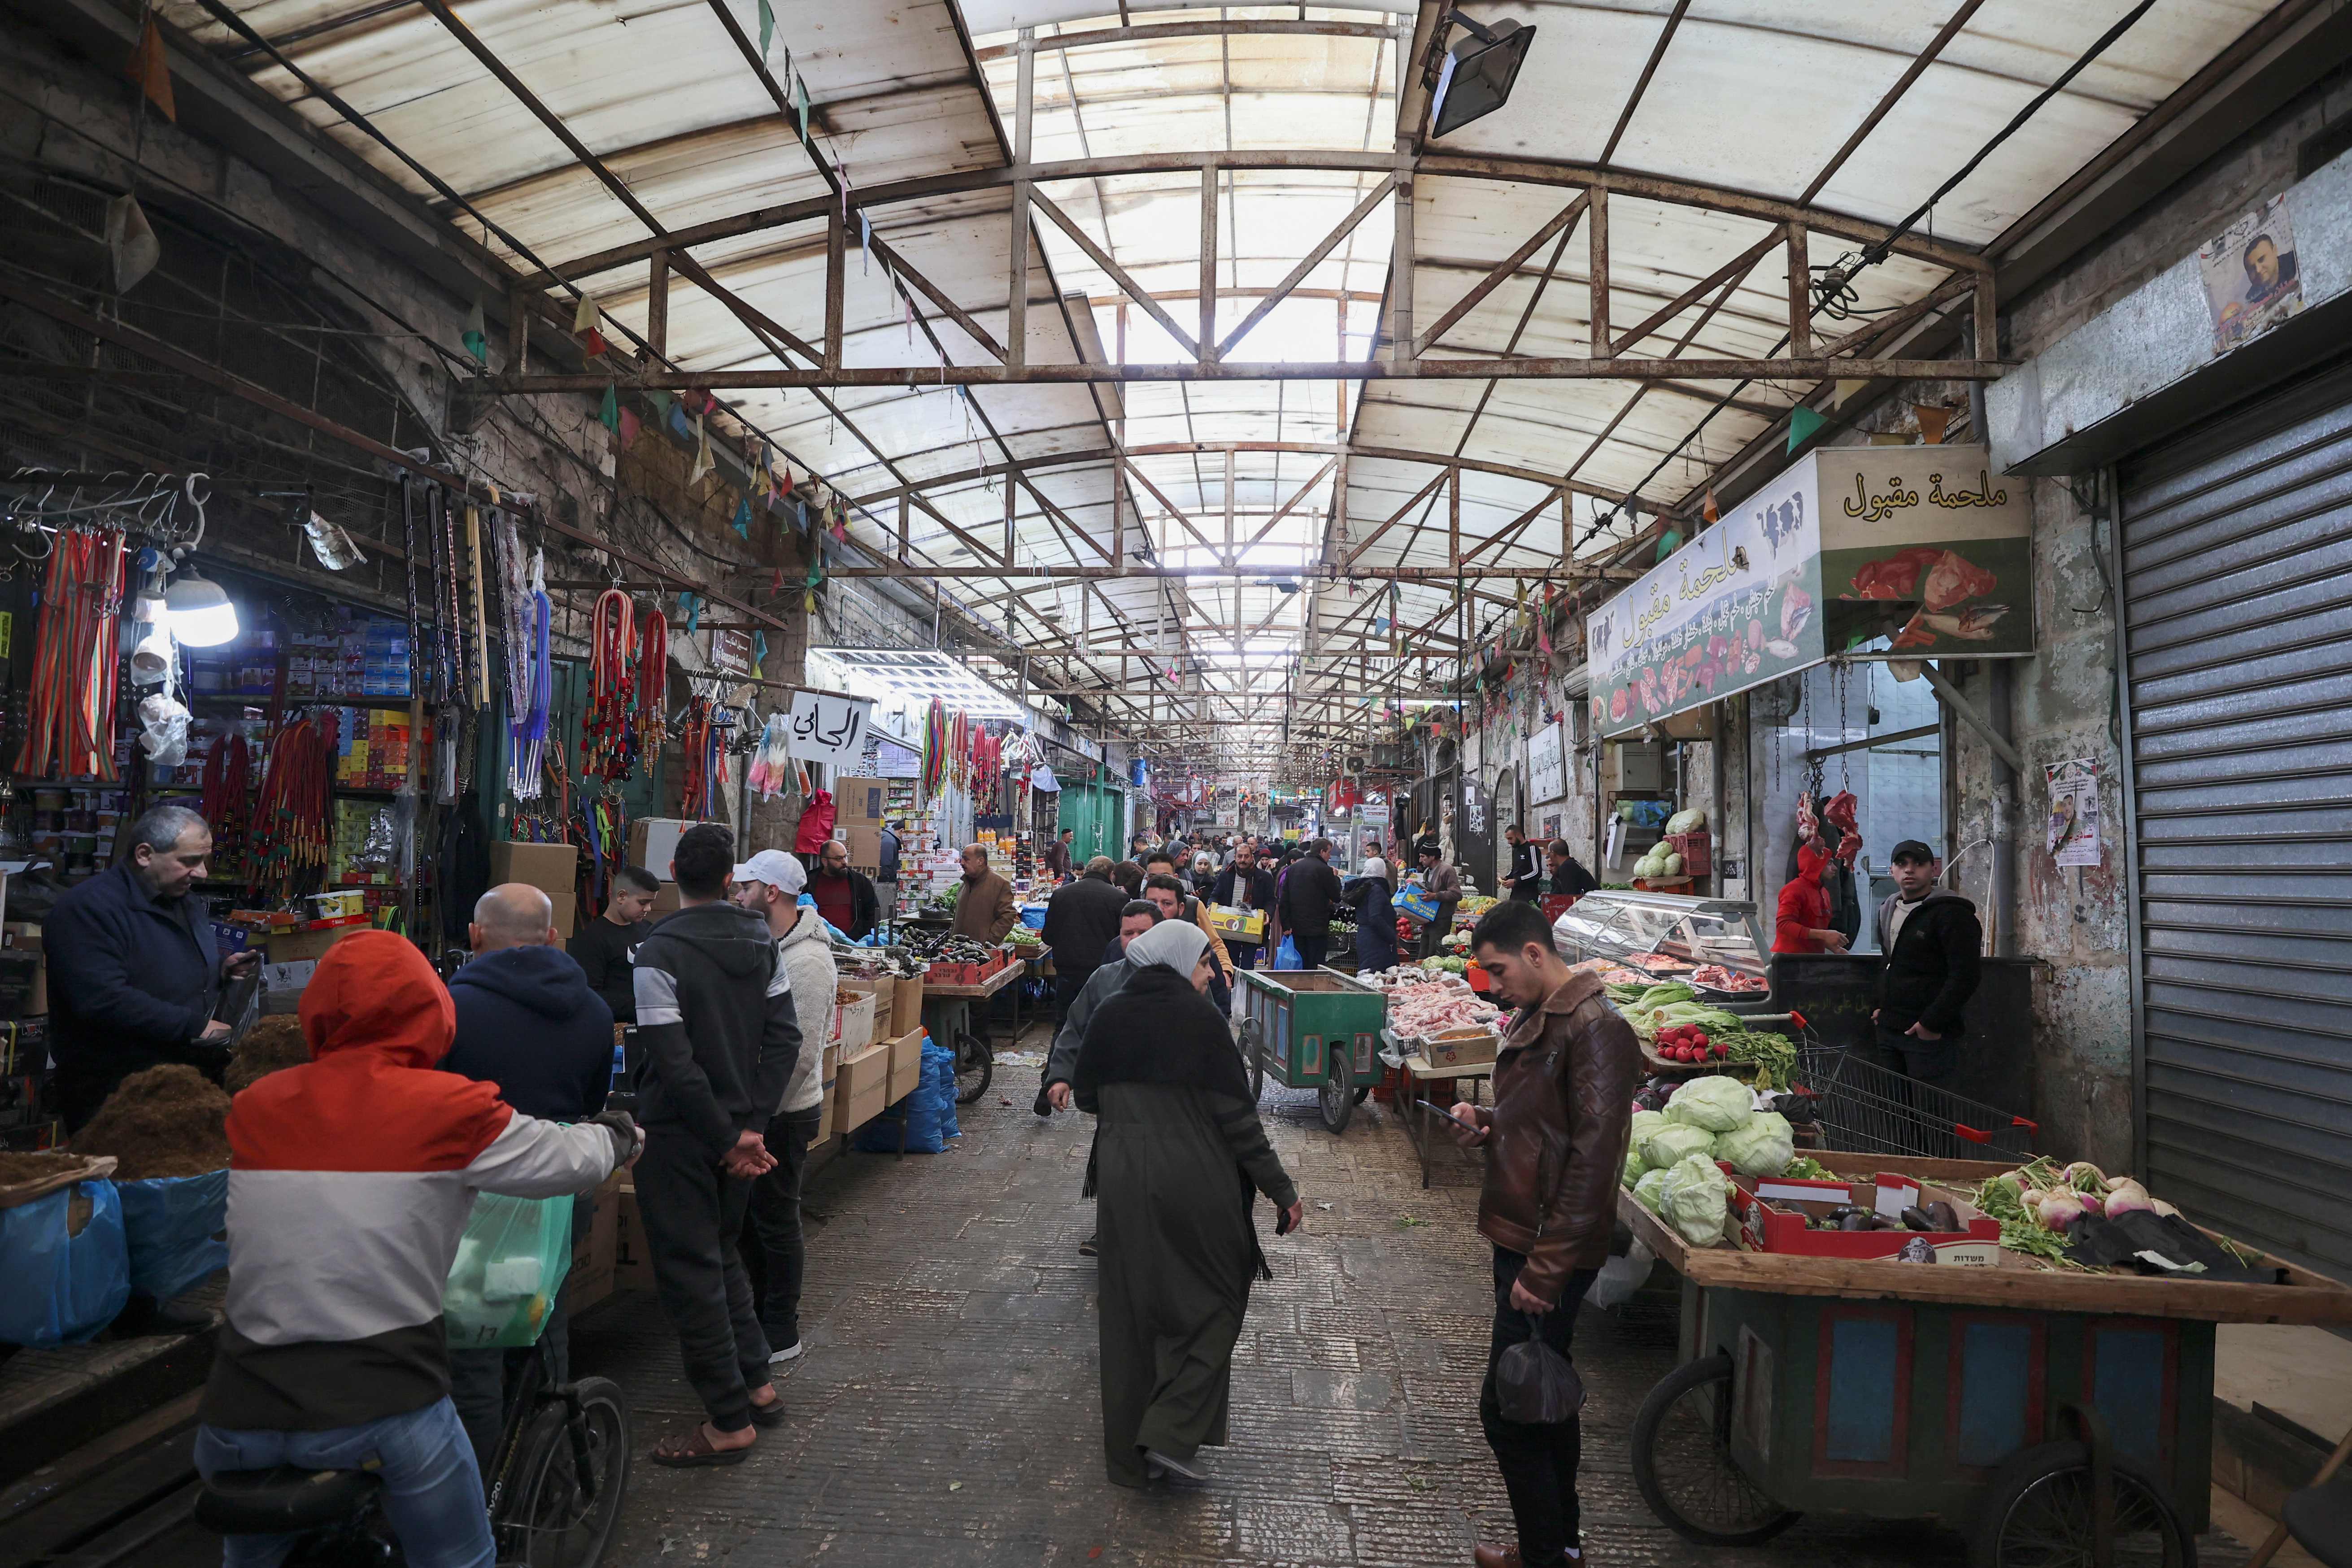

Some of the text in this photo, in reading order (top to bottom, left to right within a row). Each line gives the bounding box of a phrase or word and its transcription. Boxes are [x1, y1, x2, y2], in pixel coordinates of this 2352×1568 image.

[1844, 470, 2007, 523] ملحمة مقبول
[1622, 583, 1670, 649] مقبول
[793, 702, 860, 753] الجابي
[1224, 816, 1235, 826] 45
